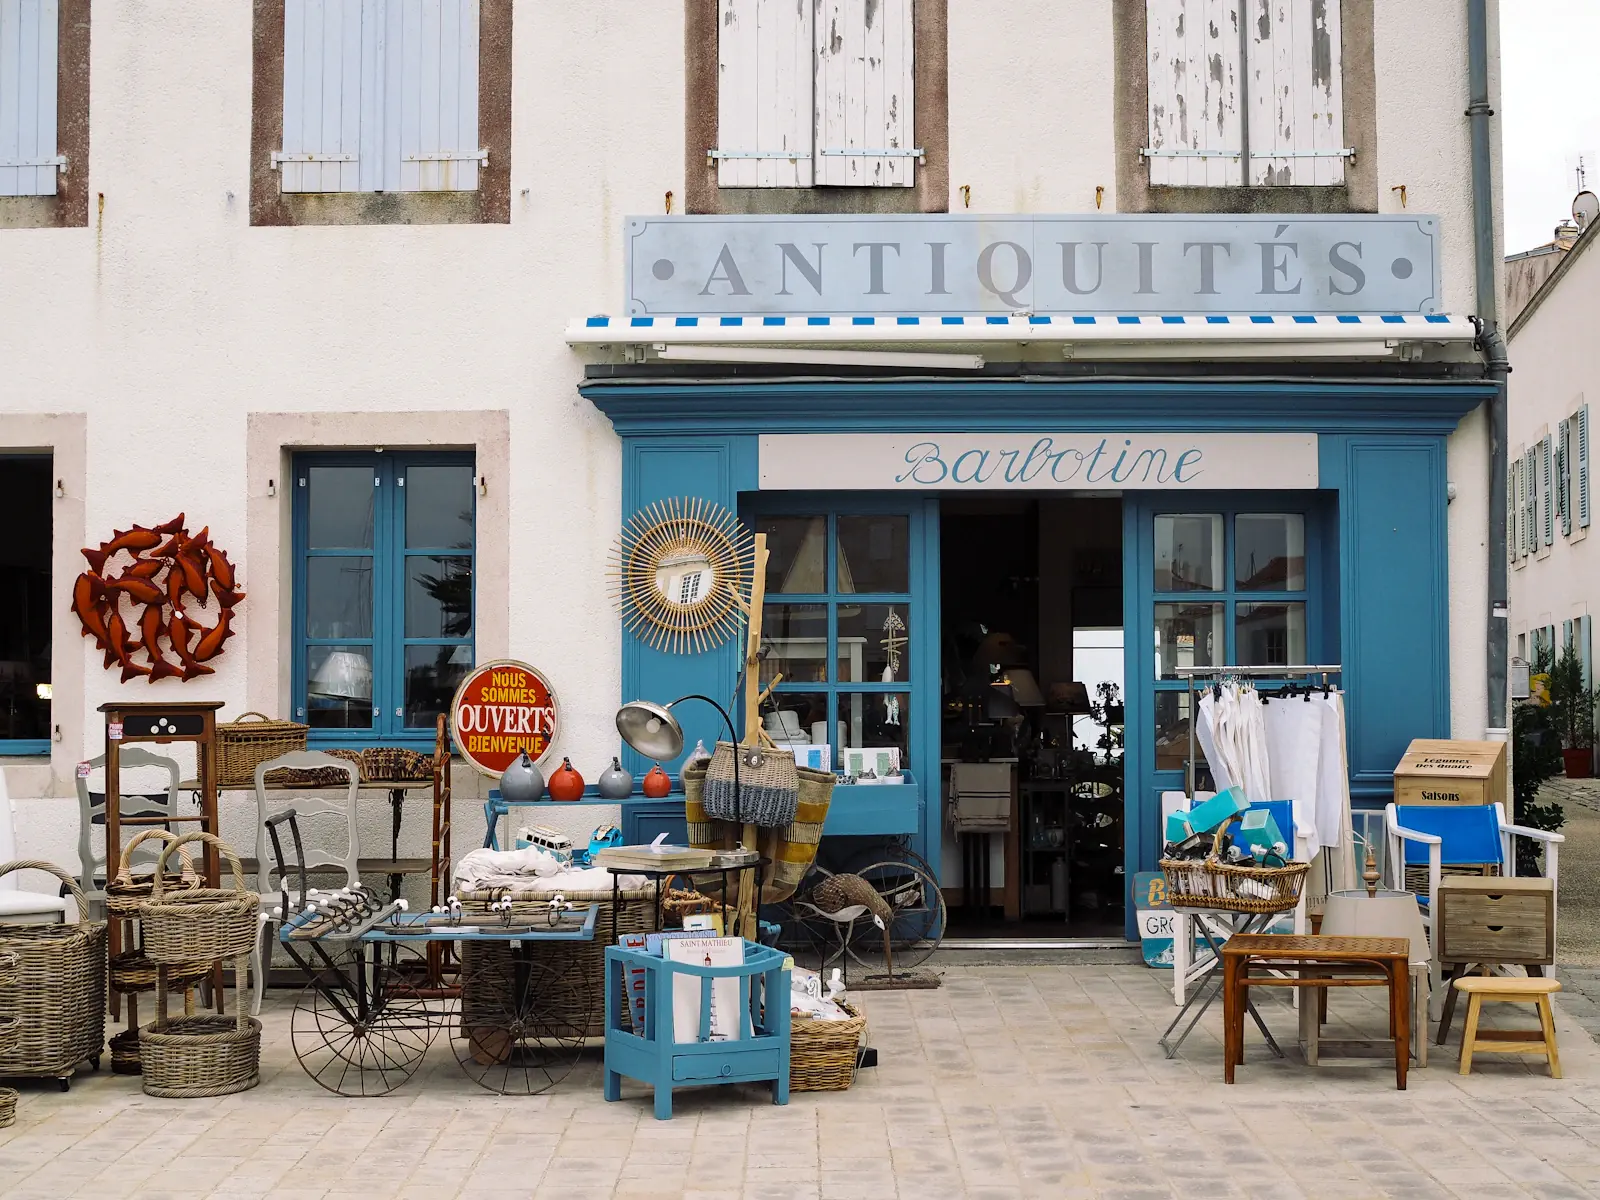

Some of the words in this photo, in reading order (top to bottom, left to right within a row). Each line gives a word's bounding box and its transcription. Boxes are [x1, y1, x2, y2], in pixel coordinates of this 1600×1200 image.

[698, 225, 1366, 307] ANTIQUITÉS
[895, 437, 1205, 484] Barbotine
[492, 672, 526, 688] NOUS
[481, 687, 536, 704] SOMMES
[458, 704, 554, 735] OUVERTS
[468, 735, 543, 754] BIENVENUE
[1421, 791, 1460, 801] Saisons
[680, 940, 700, 948] SAINT
[702, 939, 733, 948] MATHIEU
